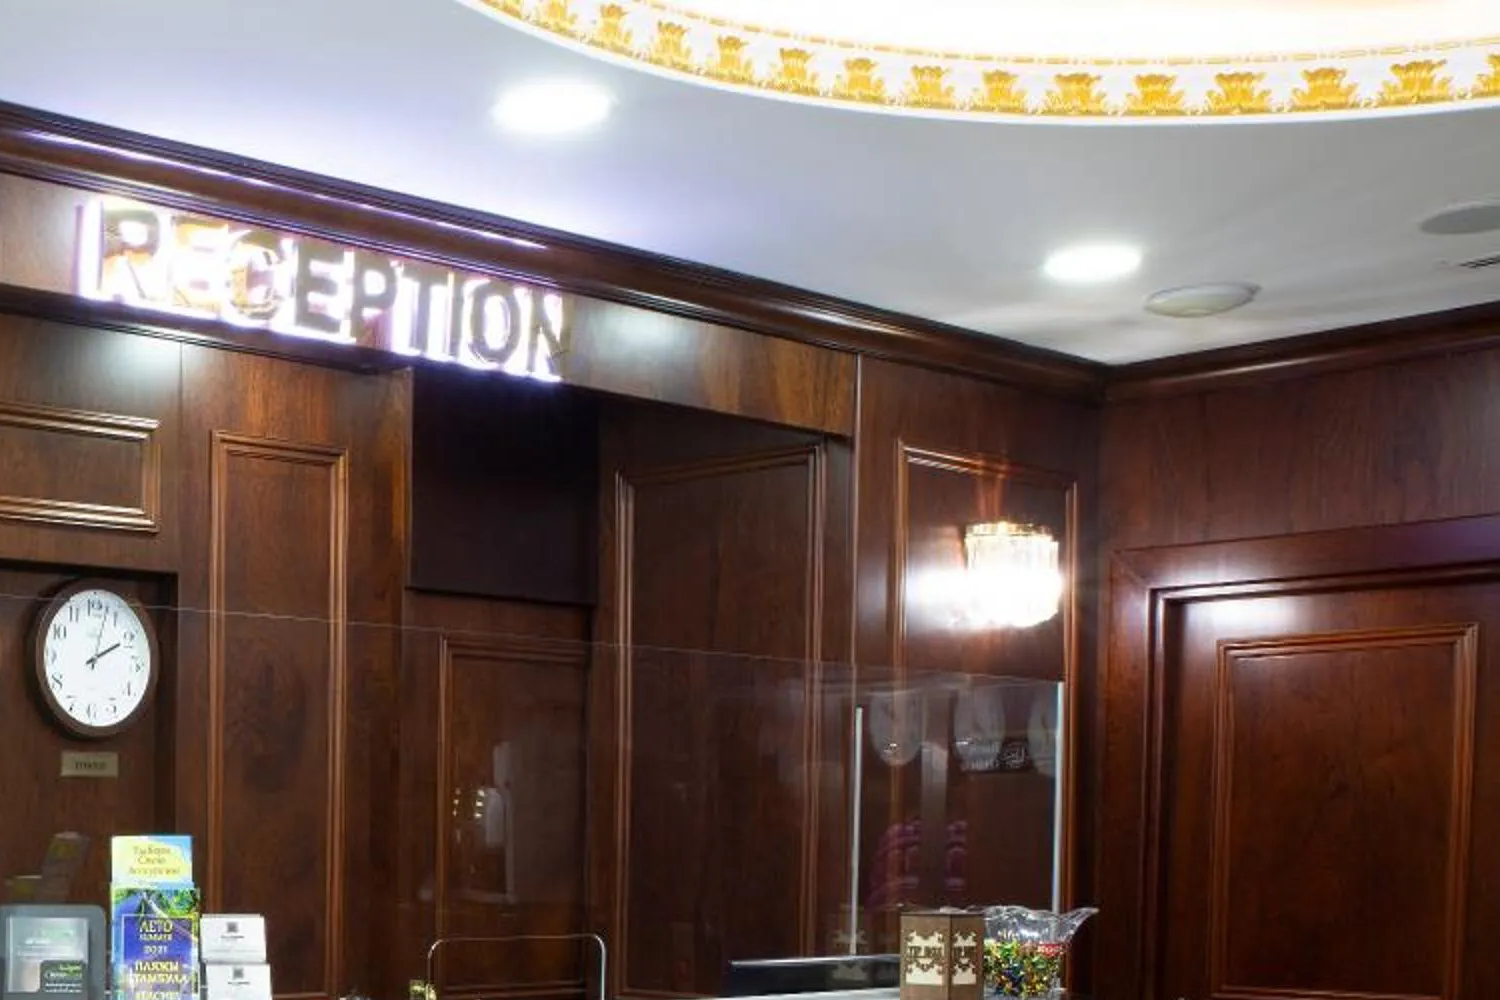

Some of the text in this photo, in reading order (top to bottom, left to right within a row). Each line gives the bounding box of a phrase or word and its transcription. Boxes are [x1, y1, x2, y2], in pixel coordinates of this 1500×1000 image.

[77, 199, 577, 383] RECEPTION
[69, 605, 80, 622] 11
[87, 599, 102, 617] 12
[53, 624, 67, 640] 10
[122, 630, 135, 648] 2
[52, 673, 63, 690] 8
